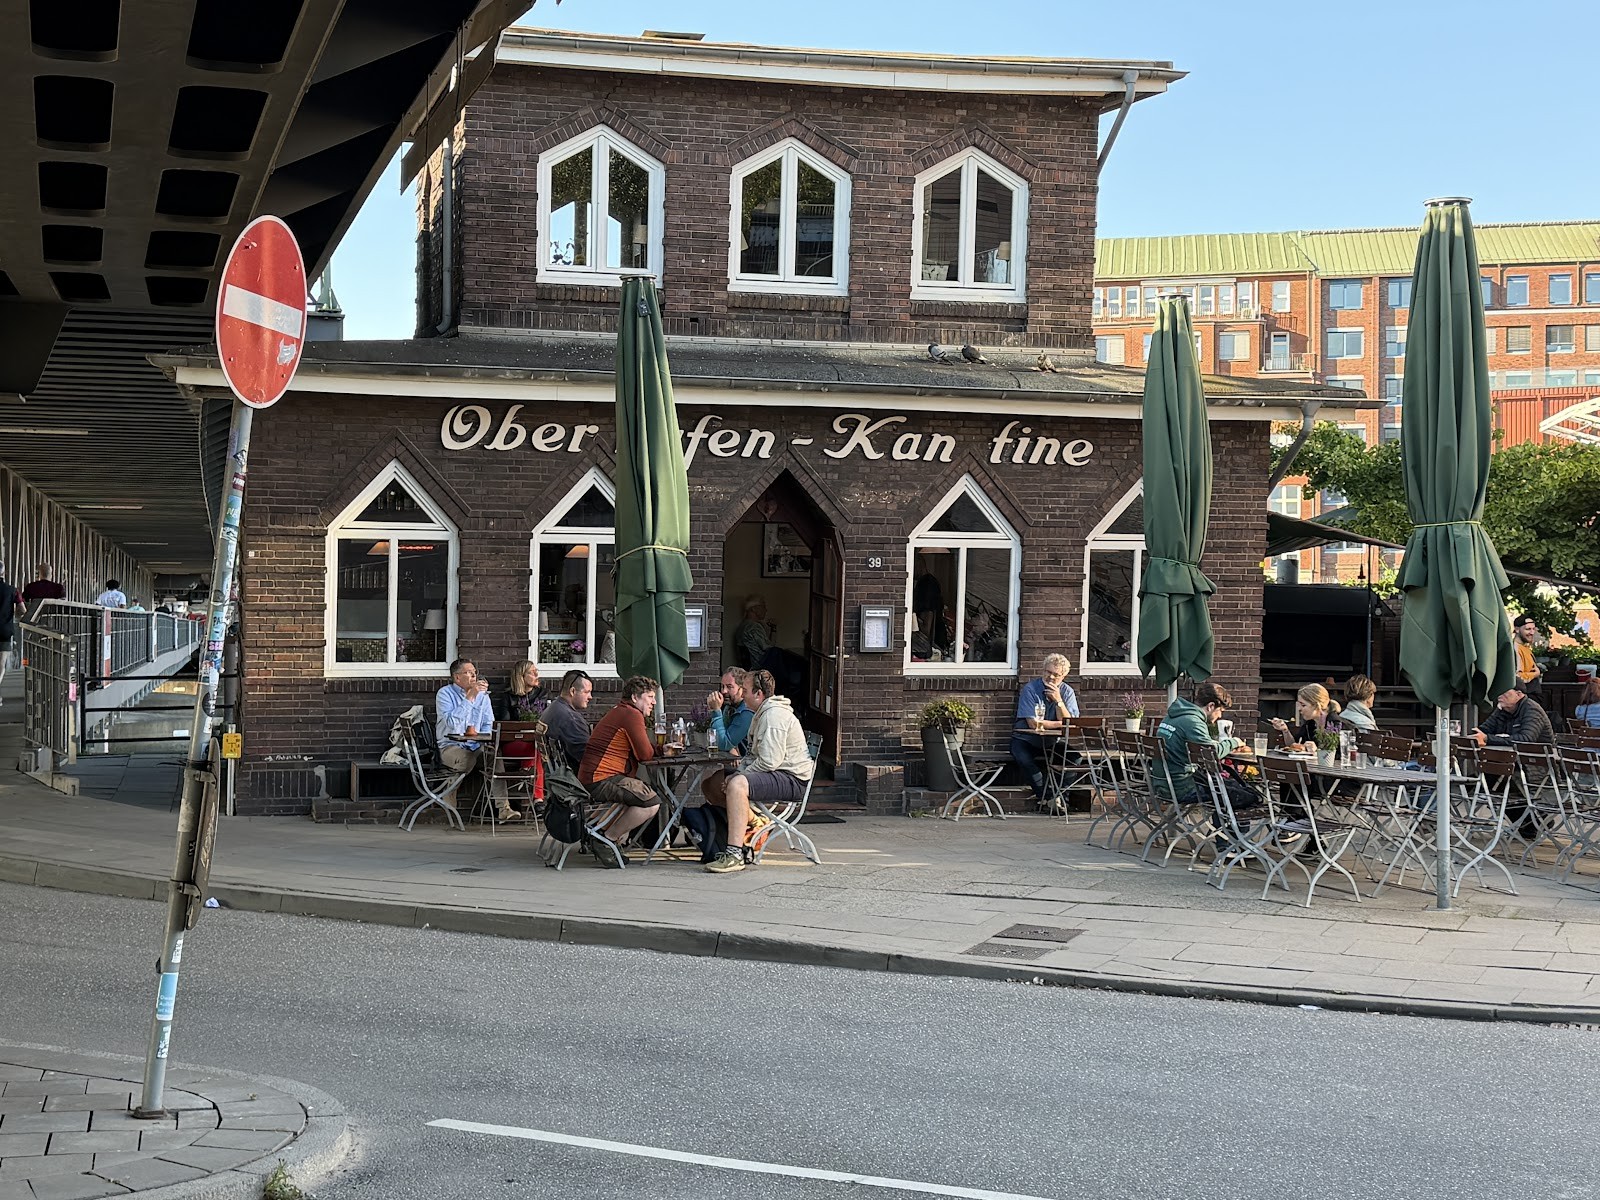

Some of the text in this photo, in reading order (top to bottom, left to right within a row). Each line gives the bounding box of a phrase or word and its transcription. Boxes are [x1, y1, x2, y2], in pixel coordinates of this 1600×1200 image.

[440, 404, 600, 453] Ober
[679, 414, 776, 471] fen
[823, 413, 956, 463] Kan
[868, 557, 881, 568] 39
